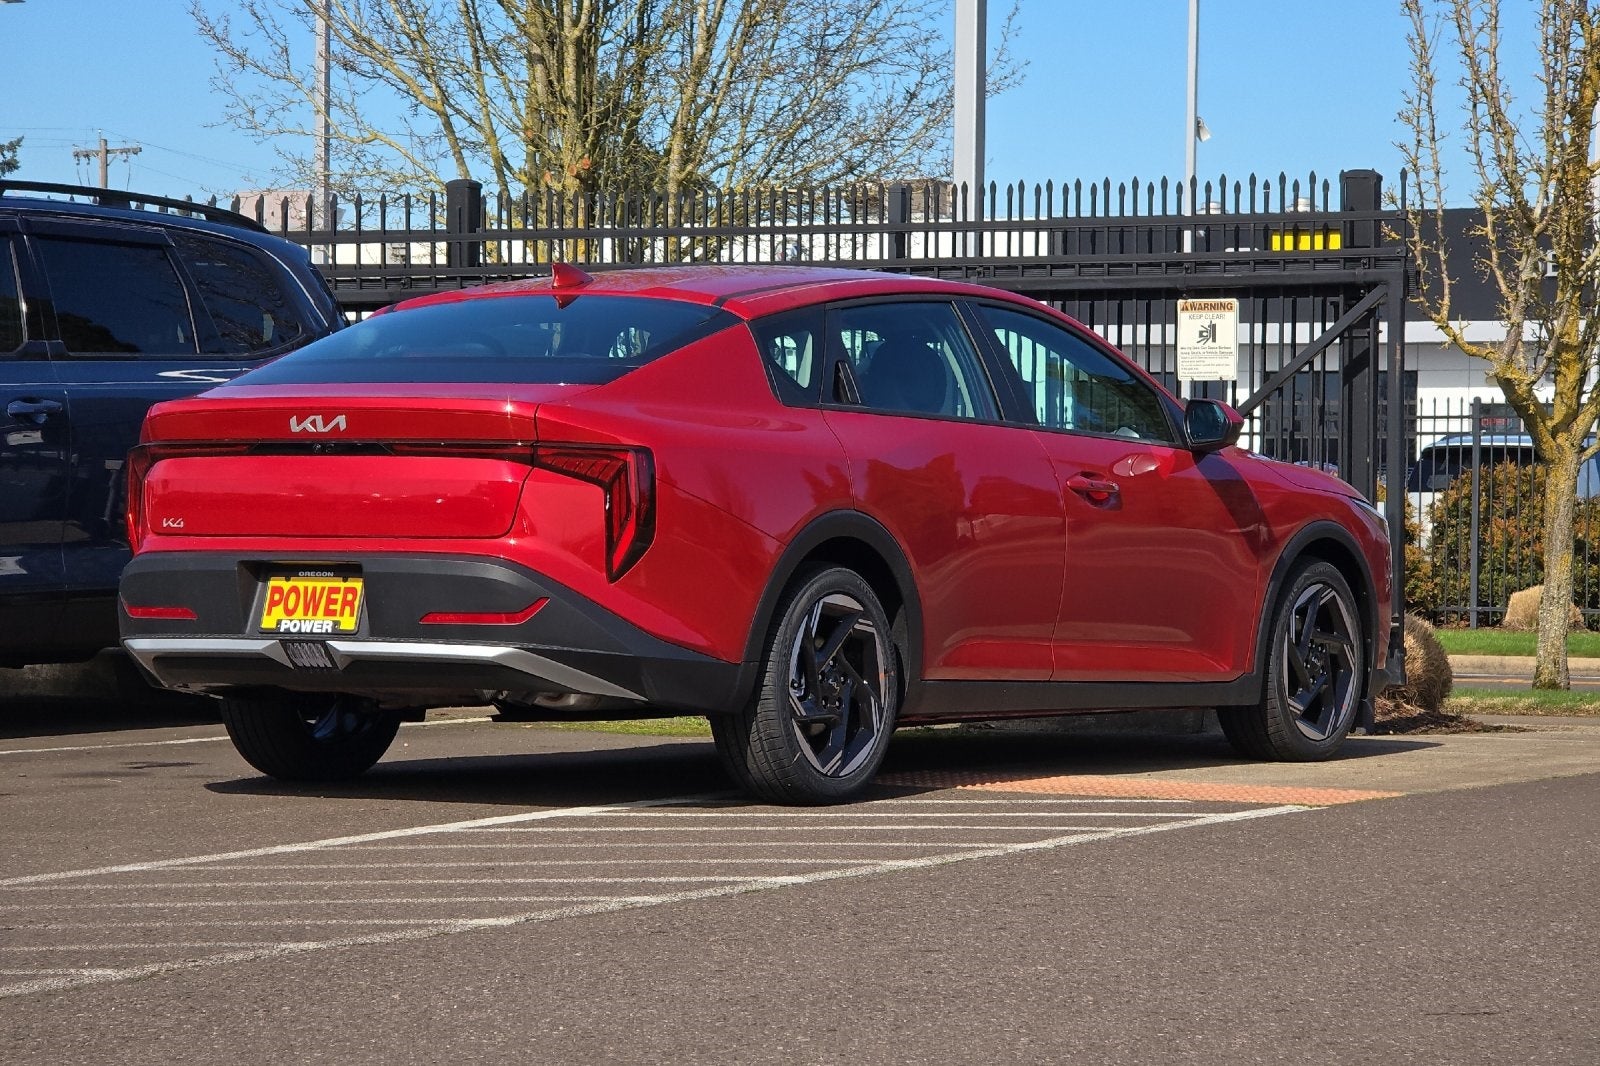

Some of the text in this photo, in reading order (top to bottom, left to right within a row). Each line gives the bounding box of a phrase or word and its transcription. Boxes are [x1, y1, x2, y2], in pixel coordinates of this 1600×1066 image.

[1189, 301, 1233, 311] WARNING
[289, 414, 347, 433] KIA
[162, 517, 184, 528] K4
[265, 585, 358, 618] POWER
[279, 619, 334, 633] POWER
